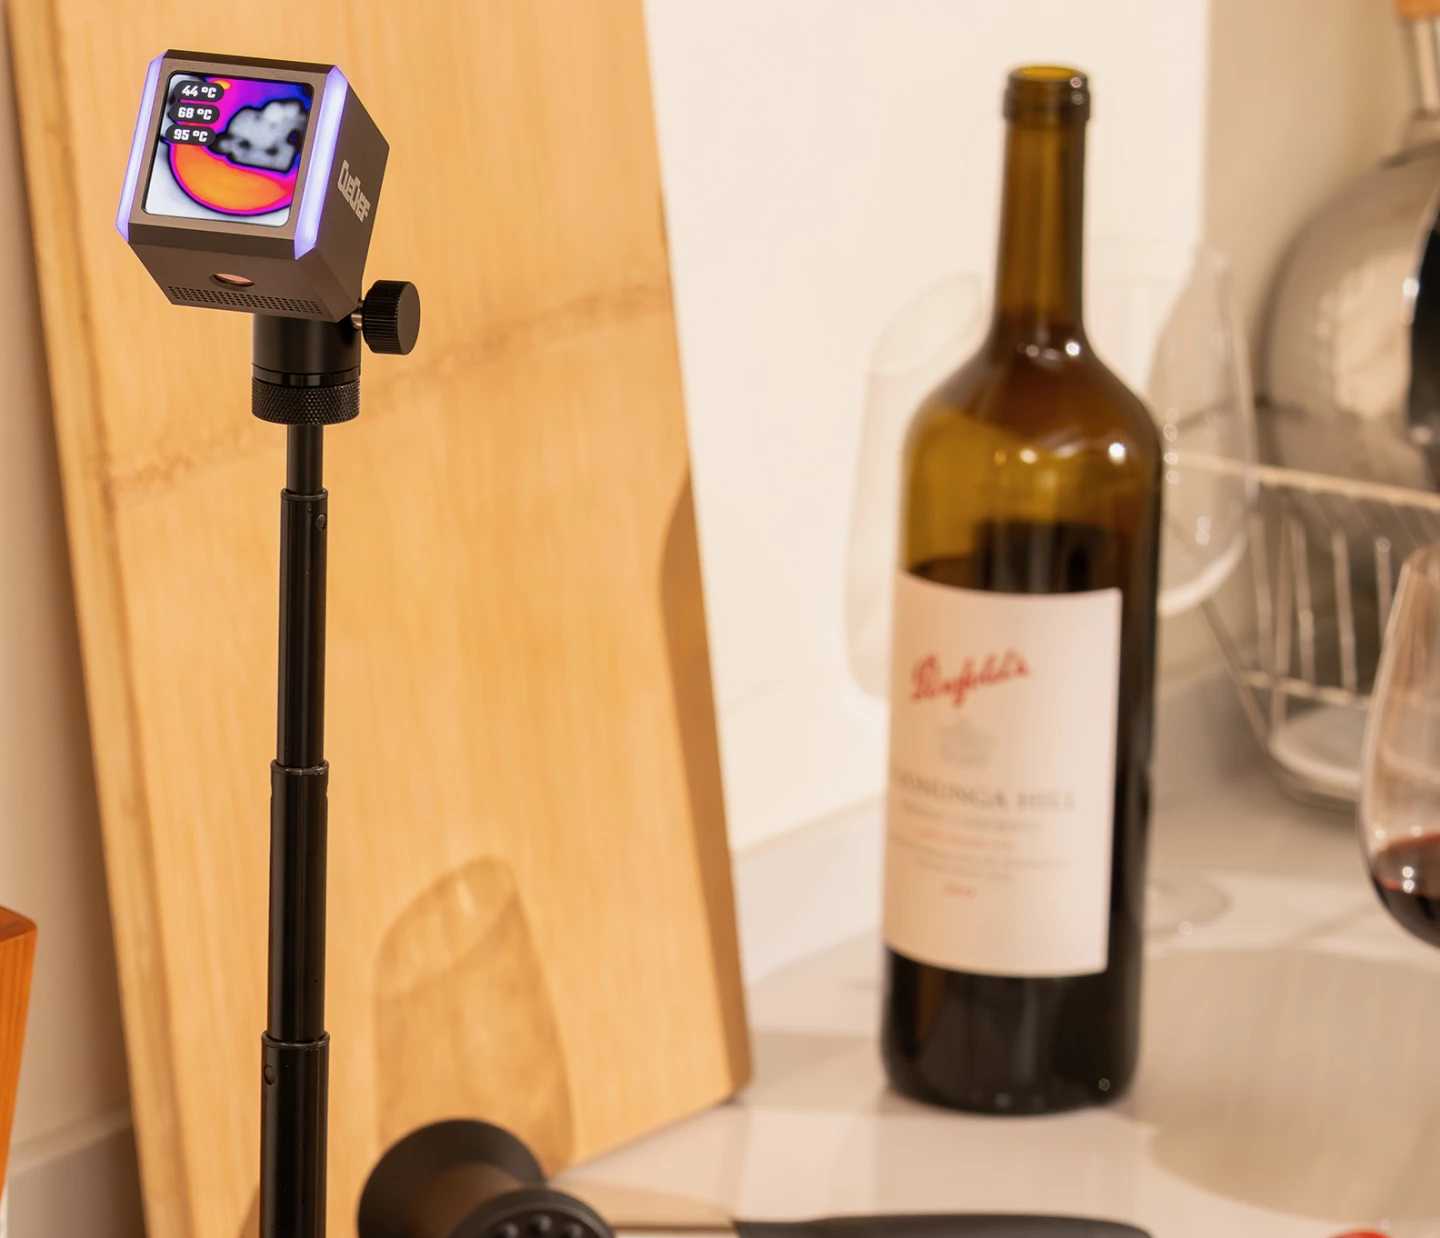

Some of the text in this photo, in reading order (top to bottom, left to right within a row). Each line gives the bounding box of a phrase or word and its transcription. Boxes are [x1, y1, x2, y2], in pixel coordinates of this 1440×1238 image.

[181, 84, 217, 99] 44 °C
[177, 106, 213, 121] 68 °C
[173, 128, 208, 143] 95 °C
